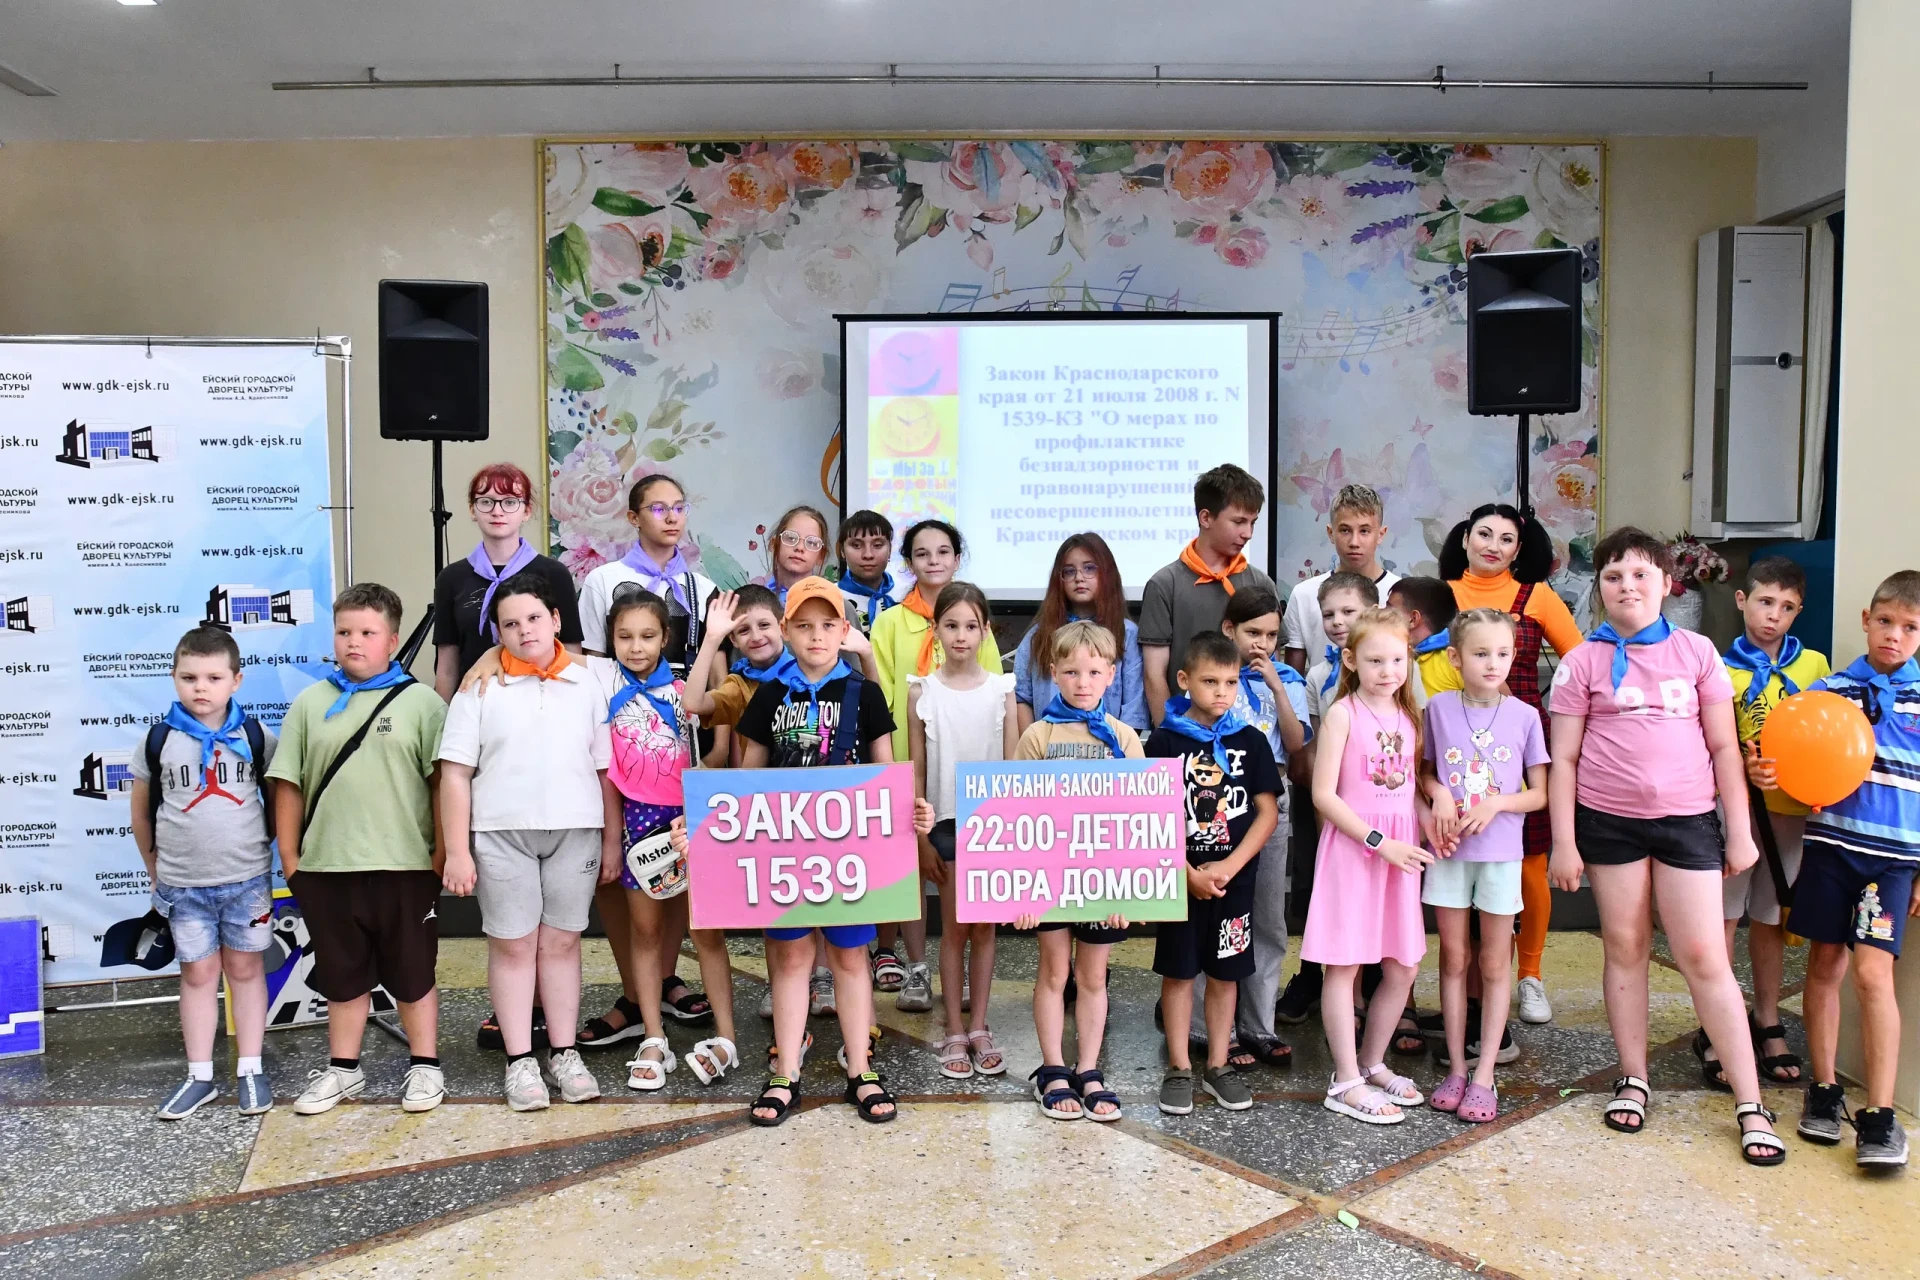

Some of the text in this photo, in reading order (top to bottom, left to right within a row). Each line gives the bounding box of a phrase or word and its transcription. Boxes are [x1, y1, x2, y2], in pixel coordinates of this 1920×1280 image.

[0, 371, 32, 381] ДСКОЙ
[202, 374, 296, 383] ЕЙСКИЙ ГОРОДСКОЙ
[984, 365, 1219, 384] Закон Краснодарского
[62, 379, 170, 394] www.gdk-ejsk.ru
[207, 385, 294, 394] ДВОРЕЦ КУЛЬТУРЫ
[978, 391, 1027, 408] края
[1034, 391, 1056, 404] от
[1063, 388, 1084, 404] 21
[1092, 390, 1146, 403] июля
[1154, 387, 1198, 403] 2008
[1225, 386, 1240, 402] N
[1002, 410, 1083, 427] 1539-КЗ
[1127, 411, 1187, 429] мерах
[1194, 411, 1218, 425] по
[200, 434, 302, 449] www.gdk-ejsk.ru
[1034, 433, 1185, 453] профилактике
[1019, 457, 1199, 475] безнадзорности и
[0, 487, 38, 497] ОДСКОЙ
[206, 485, 300, 495] ЕЙСКИЙ ГОРОДСКОЙ
[67, 493, 174, 507] www.gdk-ejsk.ru
[212, 496, 298, 504] ДВОРЕЦ КУЛЬТУРЫ
[990, 504, 1196, 523] несовершеннолетни
[77, 540, 174, 550] ЕЙСКИЙ ГОРОДСКОЙ
[201, 544, 304, 559] www.gdk-ejsk.ru
[74, 602, 180, 618] www.gdk-ejsk.ru
[83, 652, 175, 662] ЕЙСКИЙ ГОРОДСКО
[239, 653, 308, 668] gdk-ejsk.ru
[0, 662, 50, 676] -ejsk.ru
[88, 664, 127, 672] ДВОРЕЦ
[256, 702, 292, 711] ГОРОДС
[0, 710, 51, 721] ОРОДСКОЙ
[379, 716, 392, 725] THE
[771, 701, 812, 732] SKIBID
[376, 725, 392, 733] KING
[0, 772, 57, 786] k-ejsk.ru
[965, 765, 1175, 799] НА КУБАНИ ЗАКОН ТАКОЙ:
[707, 787, 893, 842] ЗАКОН
[0, 821, 57, 832] ГОРОДСКОЙ
[5, 832, 55, 842] КУЛЬТУРЫ
[966, 811, 1177, 859] 22:00-ДЕТЯМ
[95, 871, 134, 880] ЕЙСКИЙ
[737, 854, 868, 904] 1539
[0, 881, 63, 895] dk-ejsk.ru
[100, 882, 139, 891] ДВОРЕЦ
[967, 858, 1178, 908] ПОРА ДОМОЙ
